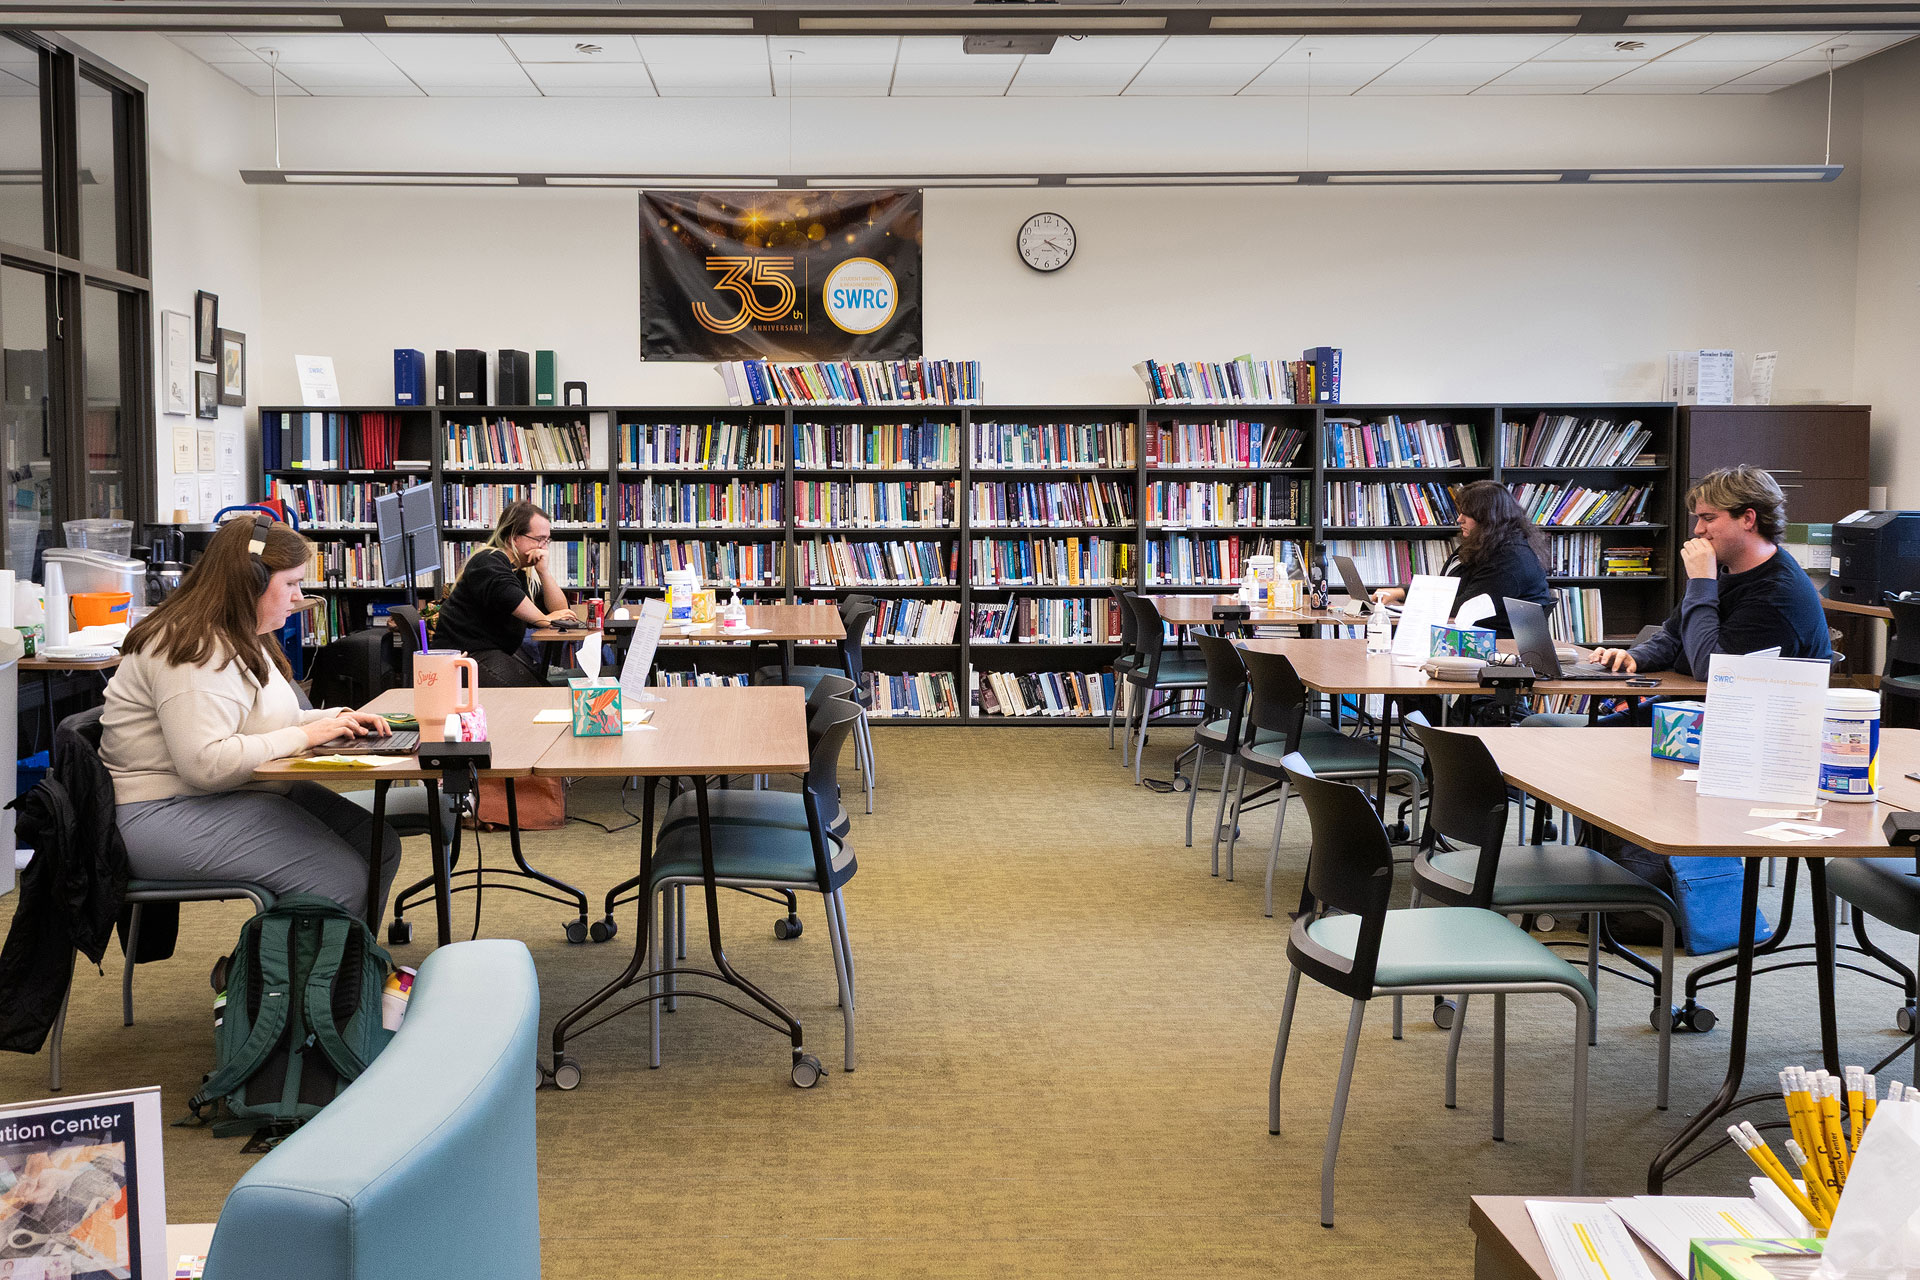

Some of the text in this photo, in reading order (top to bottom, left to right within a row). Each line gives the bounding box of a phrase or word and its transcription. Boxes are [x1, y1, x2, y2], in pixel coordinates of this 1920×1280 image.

[1033, 219, 1040, 227] 11
[1043, 215, 1052, 224] 12
[1056, 219, 1059, 227] 1
[1024, 227, 1032, 235] 10
[1063, 227, 1069, 235] 2
[1022, 238, 1027, 246] 9
[1067, 238, 1072, 246] 3
[1025, 249, 1031, 257] 8
[1044, 260, 1050, 268] 6
[833, 288, 888, 309] SWRC
[417, 670, 438, 686] Swig
[1713, 674, 1734, 684] SWRC
[50, 1114, 121, 1135] Center
